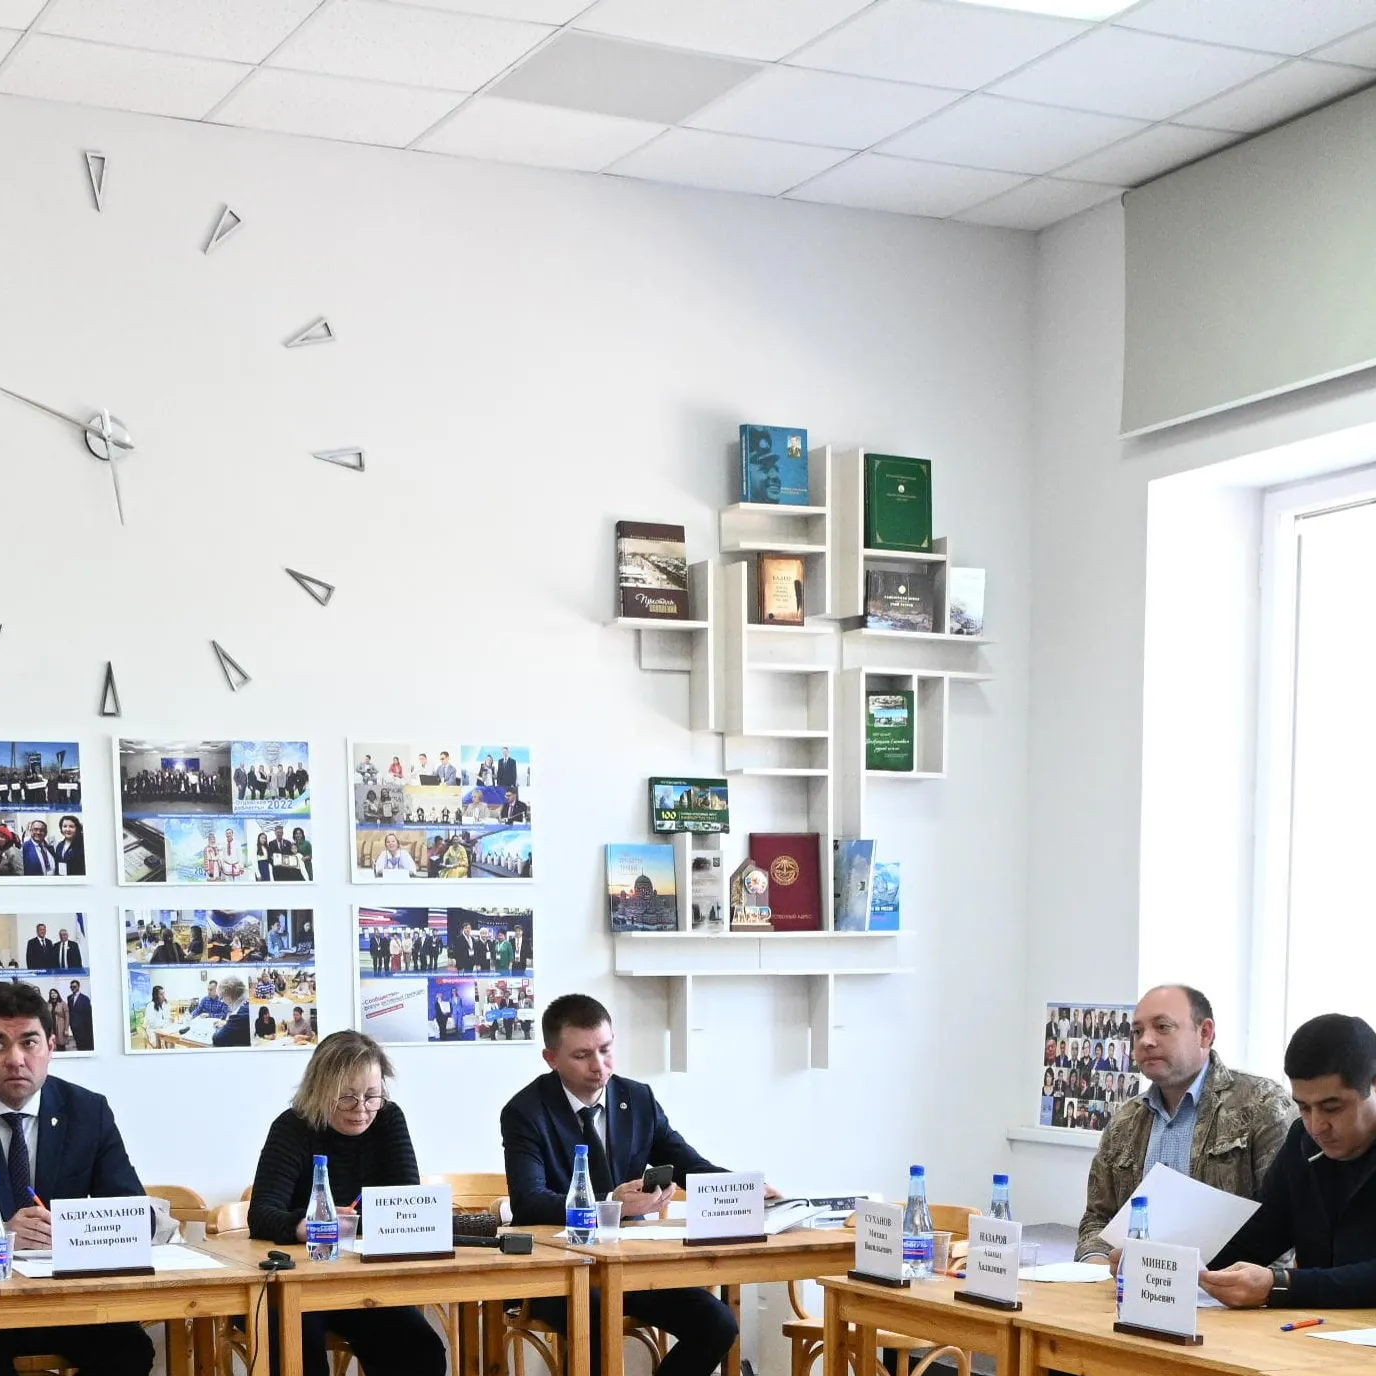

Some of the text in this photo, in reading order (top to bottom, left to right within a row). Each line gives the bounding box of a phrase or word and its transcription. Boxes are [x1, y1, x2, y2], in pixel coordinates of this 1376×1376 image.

[267, 800, 293, 810] 2022
[661, 811, 677, 820] 100
[698, 1183, 755, 1194] ИСМАГИЛОВ
[375, 1196, 437, 1207] НЕКРАСОВА
[713, 1197, 739, 1205] Ришат
[59, 1207, 145, 1221] АБДРАХМАНОВ
[396, 1211, 417, 1220] Рита
[701, 1208, 752, 1218] Салаватович
[864, 1214, 892, 1227] СУХАНОВ
[84, 1223, 122, 1234] Данияр
[378, 1225, 436, 1235] Анатольевна
[69, 1235, 138, 1247] Мавлиярович
[979, 1231, 1007, 1245] НАЗАРОВ
[1141, 1256, 1177, 1271] МИНЕЕВ
[1145, 1273, 1171, 1287] Сергей
[1141, 1288, 1175, 1304] Юрьевич
